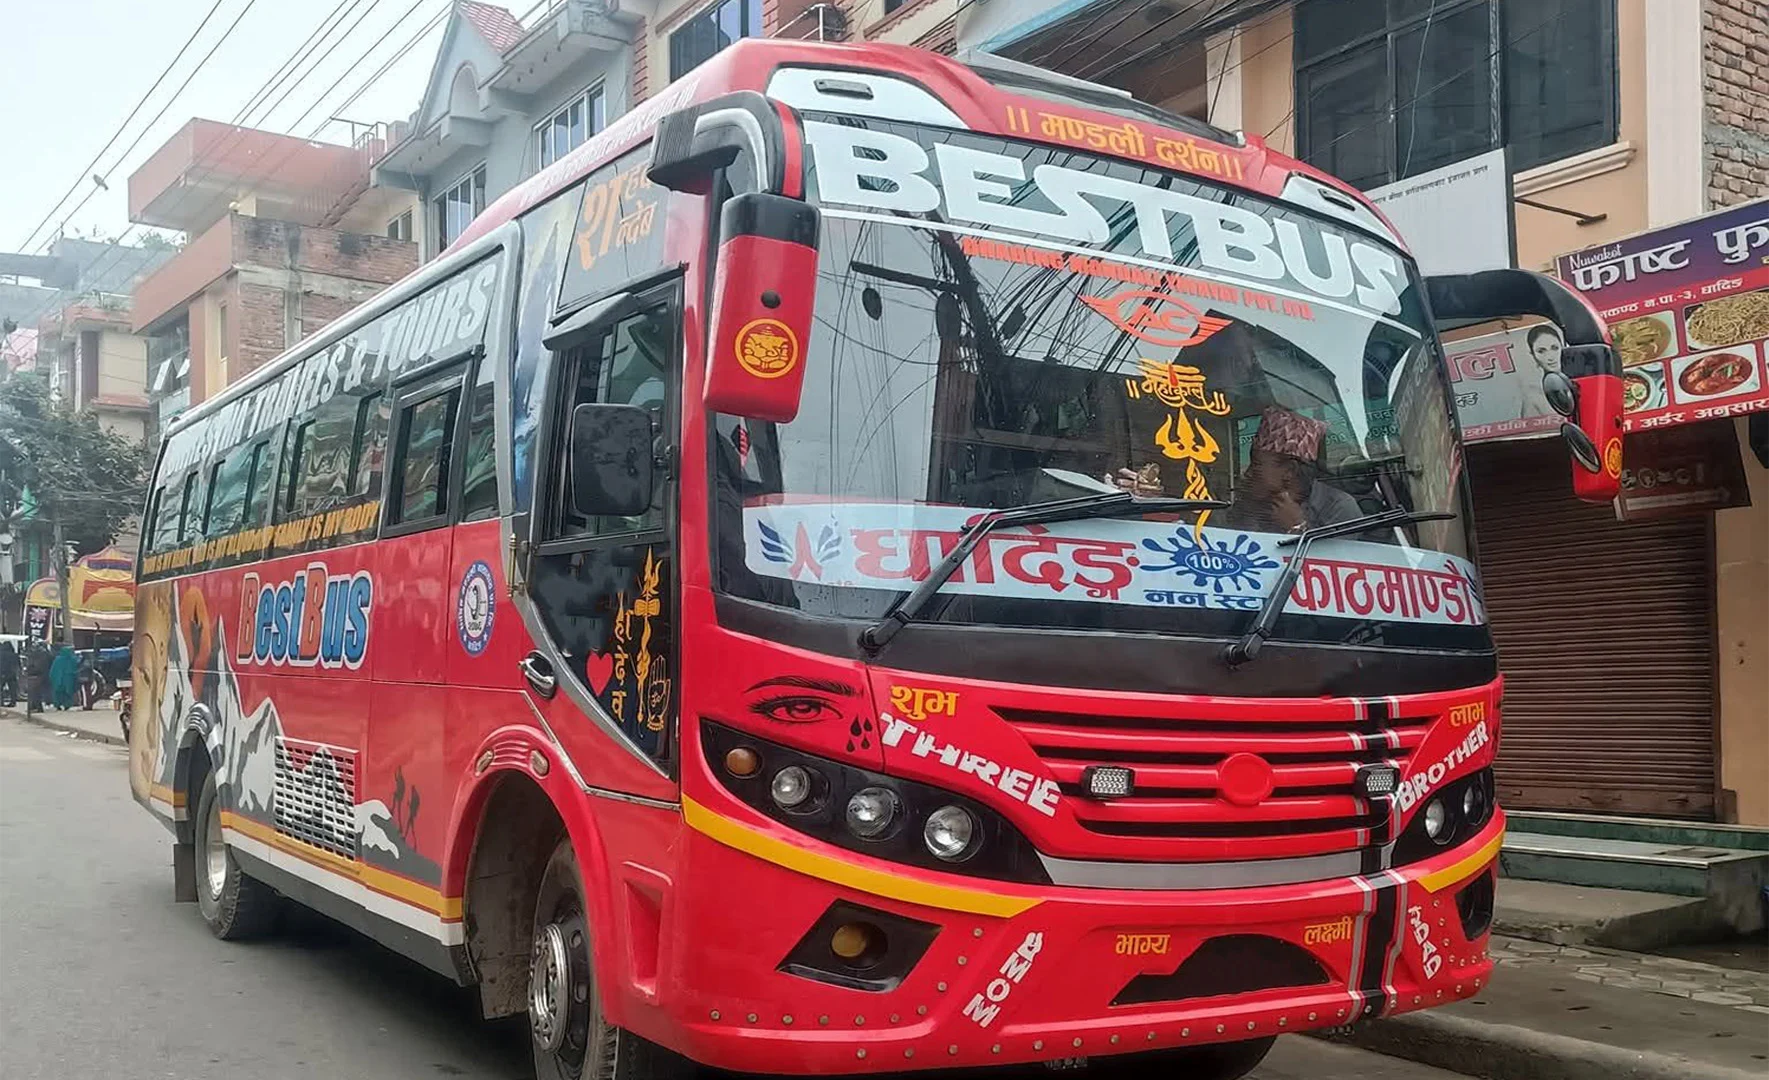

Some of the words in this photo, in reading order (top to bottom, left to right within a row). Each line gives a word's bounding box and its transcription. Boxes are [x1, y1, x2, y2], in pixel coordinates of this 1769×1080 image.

[1038, 112, 1146, 158] मण्डली
[802, 118, 1402, 316] BESTBUS
[1569, 243, 1623, 269] Nuwakot
[1571, 238, 1692, 292] फाष्ट
[372, 263, 498, 379] TOURS
[311, 511, 325, 541] IS
[324, 507, 345, 539] MY
[342, 500, 381, 534] BODY
[1189, 553, 1234, 571] 100%
[237, 561, 373, 670] BestBus
[1213, 593, 1266, 611] स्ट
[889, 684, 960, 721] शुभ
[1448, 701, 1486, 727] लाभ
[880, 711, 1063, 817] THREE
[1398, 720, 1489, 813] BROTHER
[1115, 933, 1171, 955] भाग्य
[1304, 915, 1353, 946] लक्ष्मी
